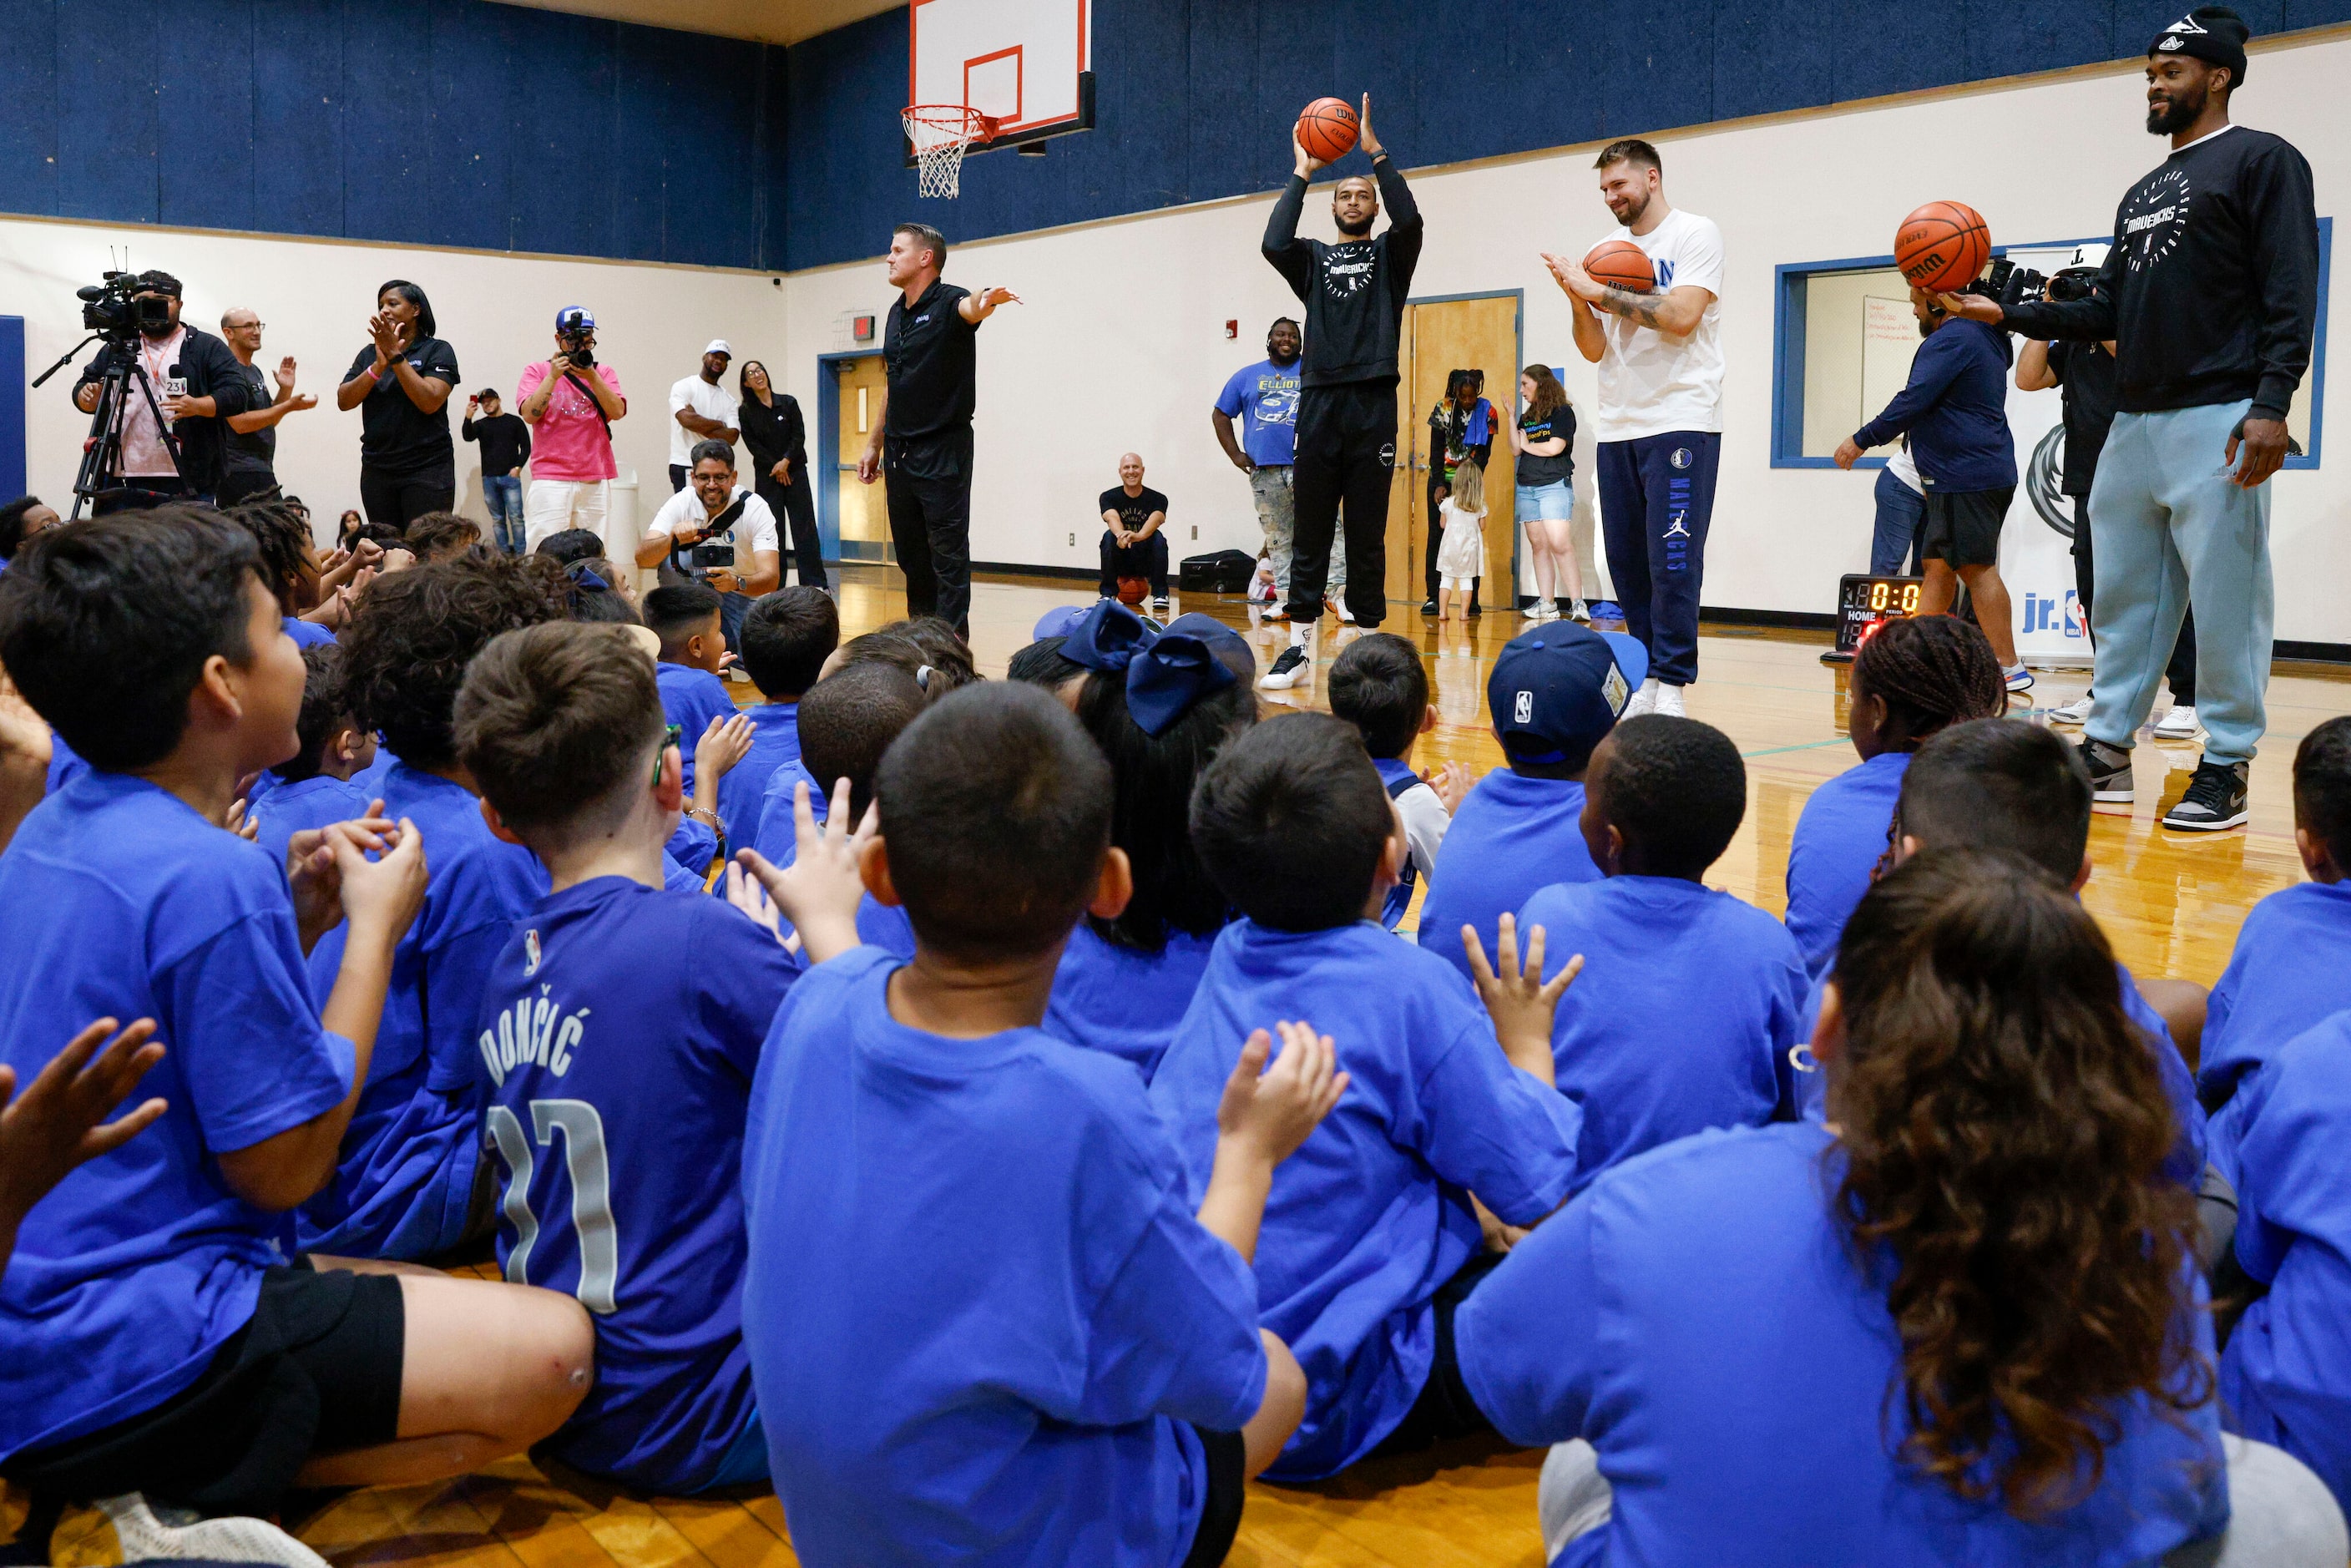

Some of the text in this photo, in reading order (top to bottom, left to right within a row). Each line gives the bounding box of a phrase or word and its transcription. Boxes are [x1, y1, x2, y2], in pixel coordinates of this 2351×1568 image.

[167, 381, 180, 392] 23
[1847, 610, 1876, 622] HOME
[2022, 593, 2060, 634] jr.
